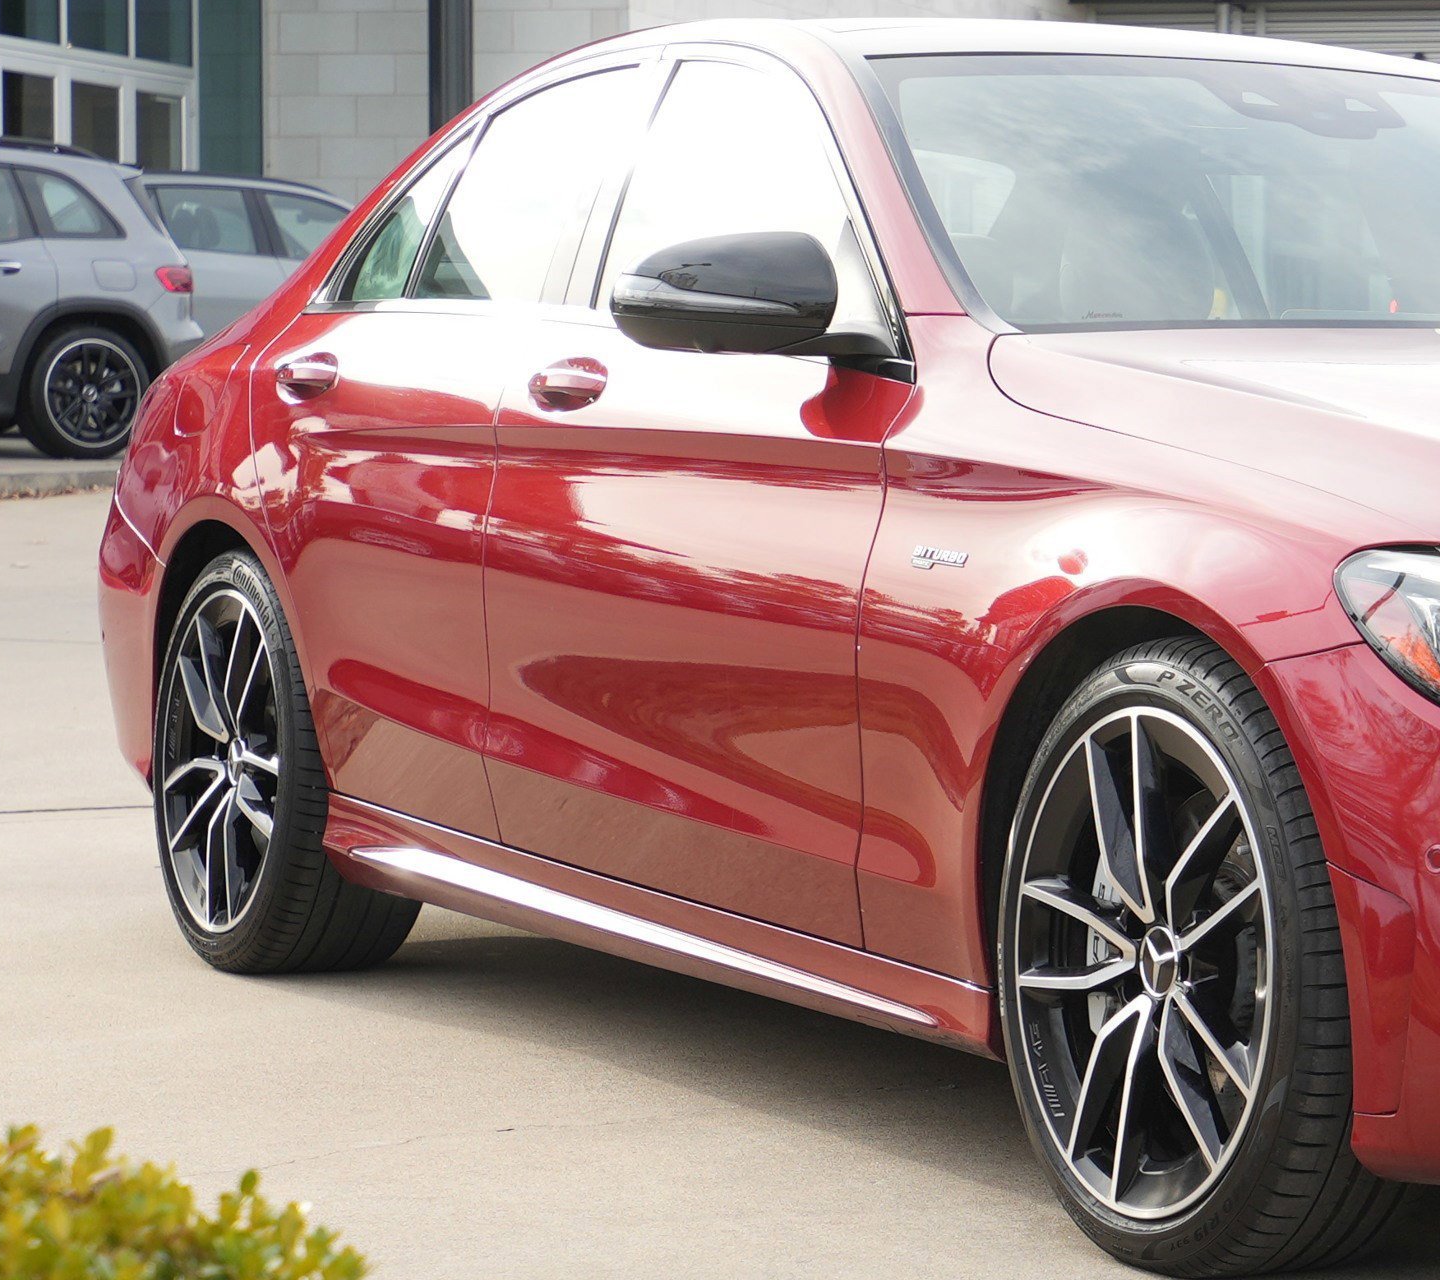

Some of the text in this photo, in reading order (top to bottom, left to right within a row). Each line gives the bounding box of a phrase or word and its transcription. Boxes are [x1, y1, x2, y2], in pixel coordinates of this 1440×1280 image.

[912, 544, 968, 565] BITURBO
[232, 564, 275, 633] Continental
[1156, 670, 1239, 742] P ZERO
